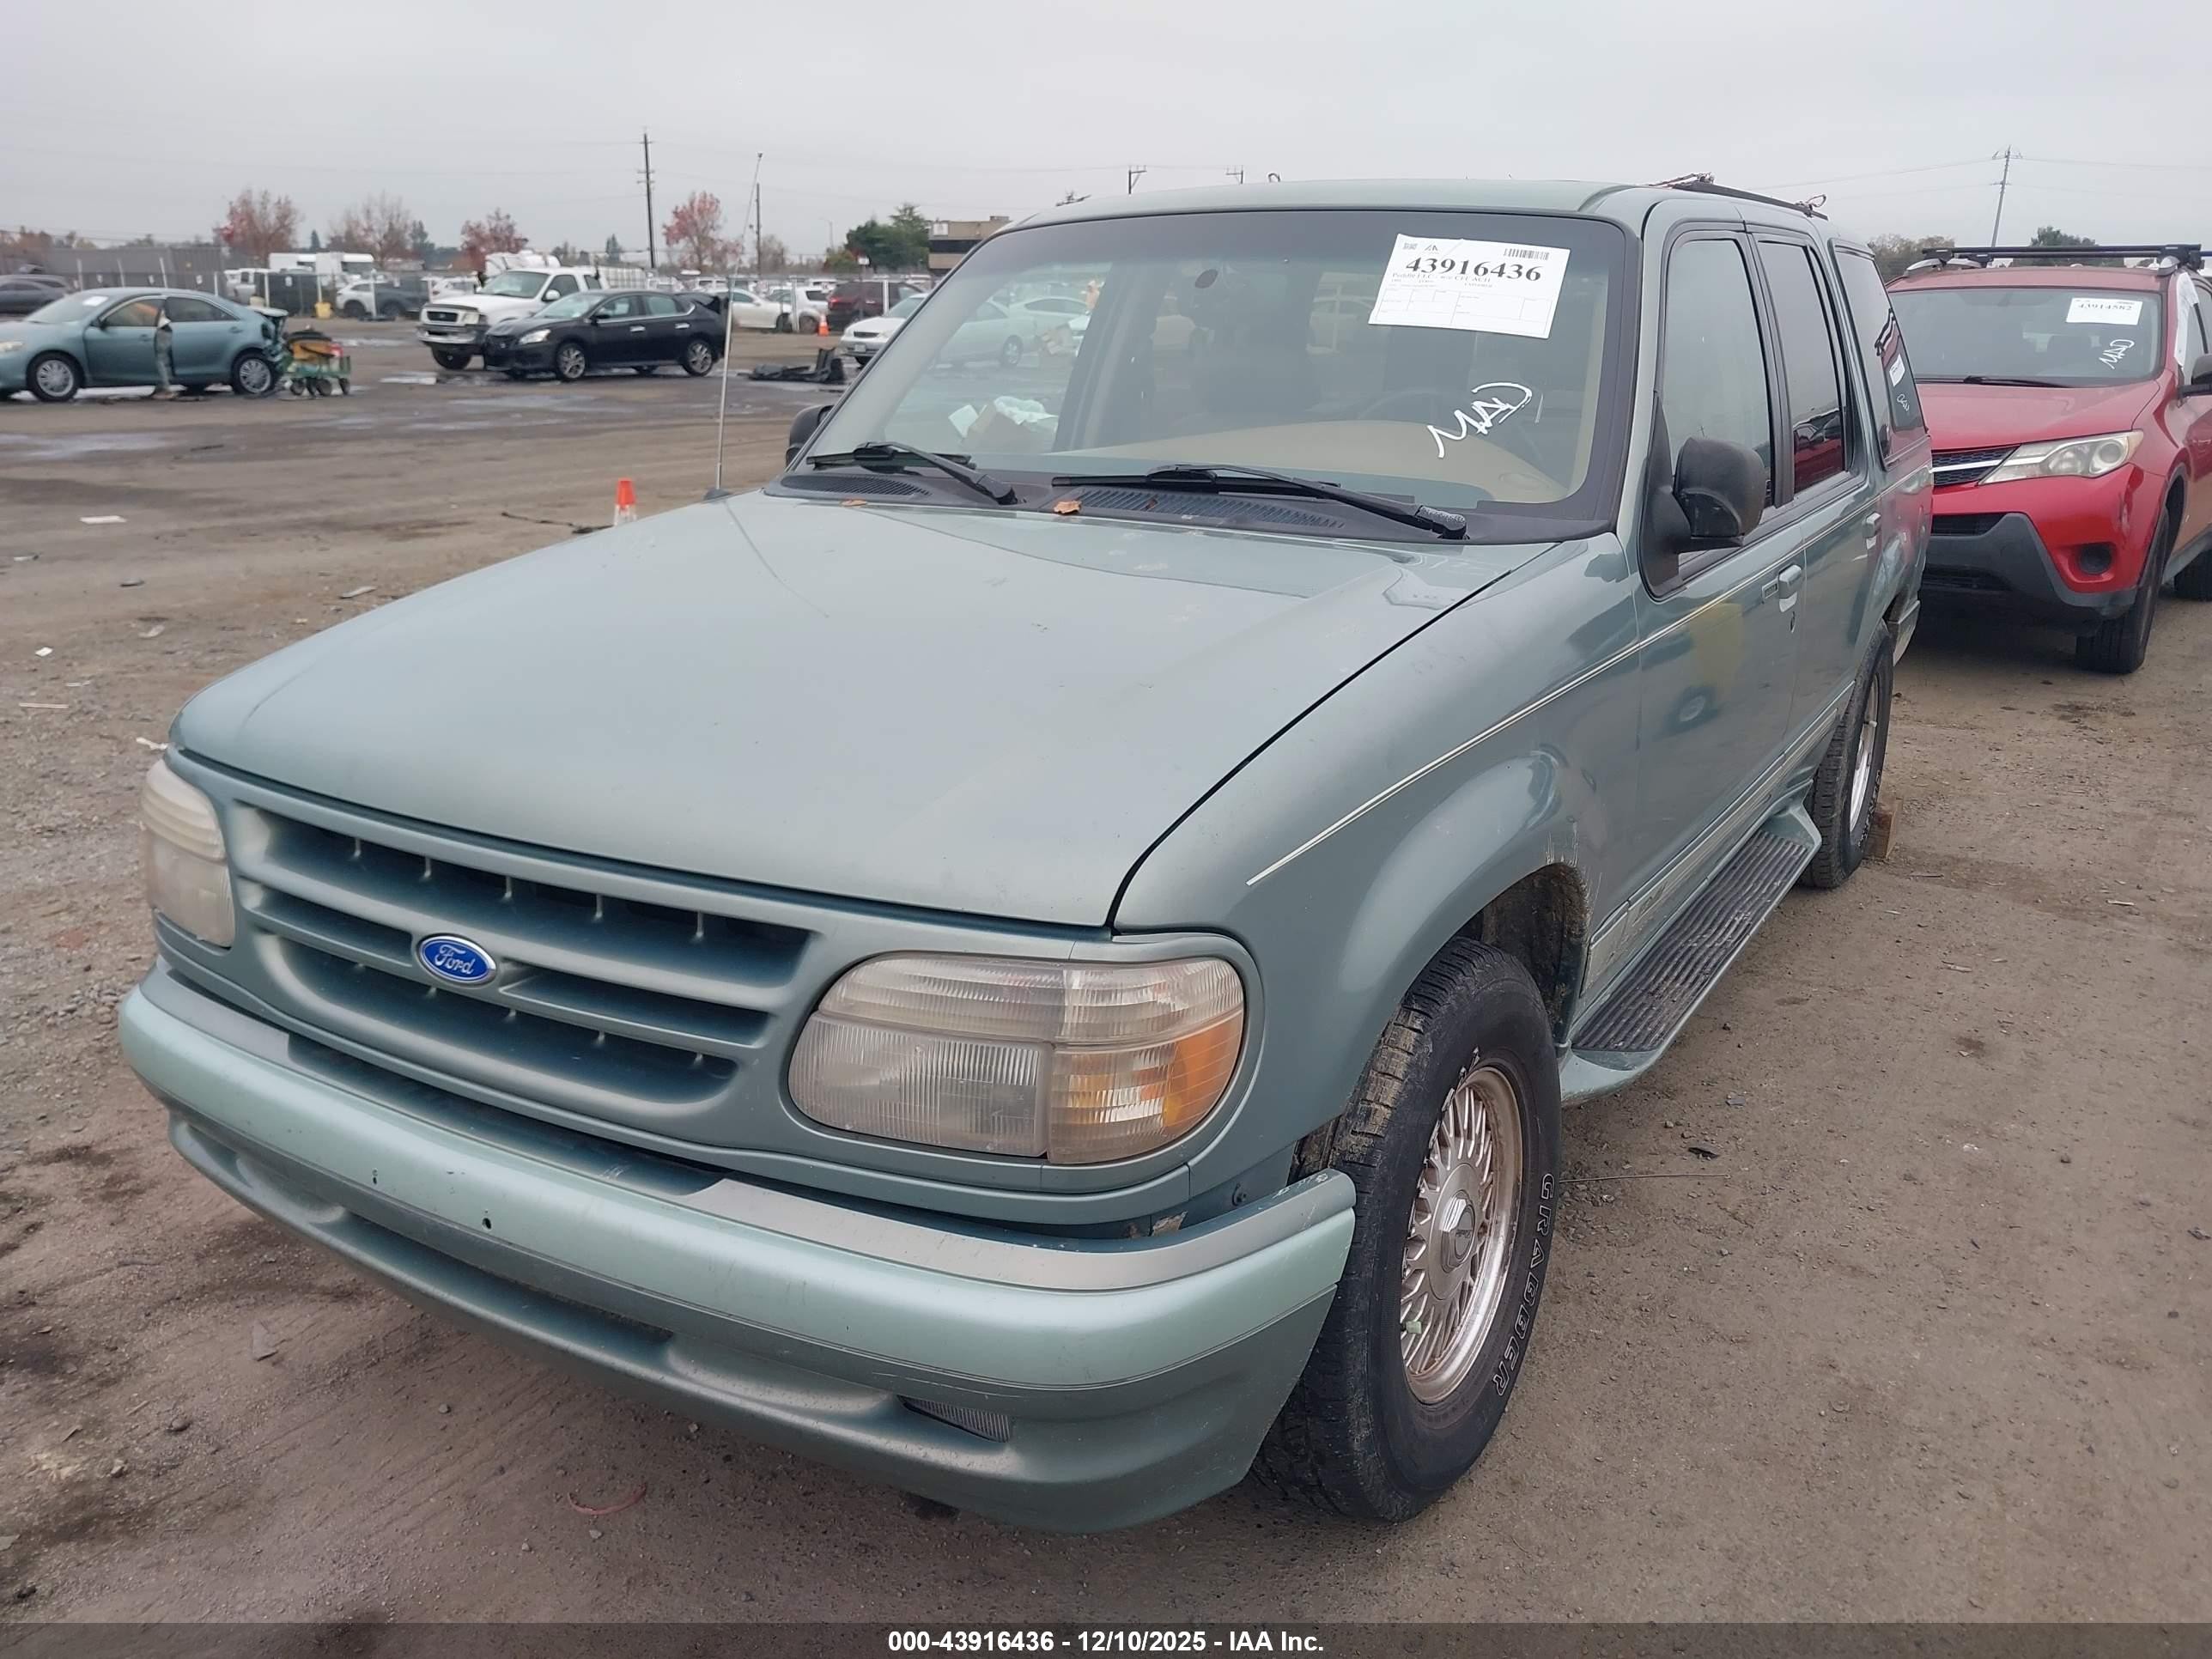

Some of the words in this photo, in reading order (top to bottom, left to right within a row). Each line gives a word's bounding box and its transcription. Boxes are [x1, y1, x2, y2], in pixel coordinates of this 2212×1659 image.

[1406, 257, 1543, 282] 43916436
[434, 944, 477, 975] Ford
[1493, 1173, 1555, 1396] GRABBER
